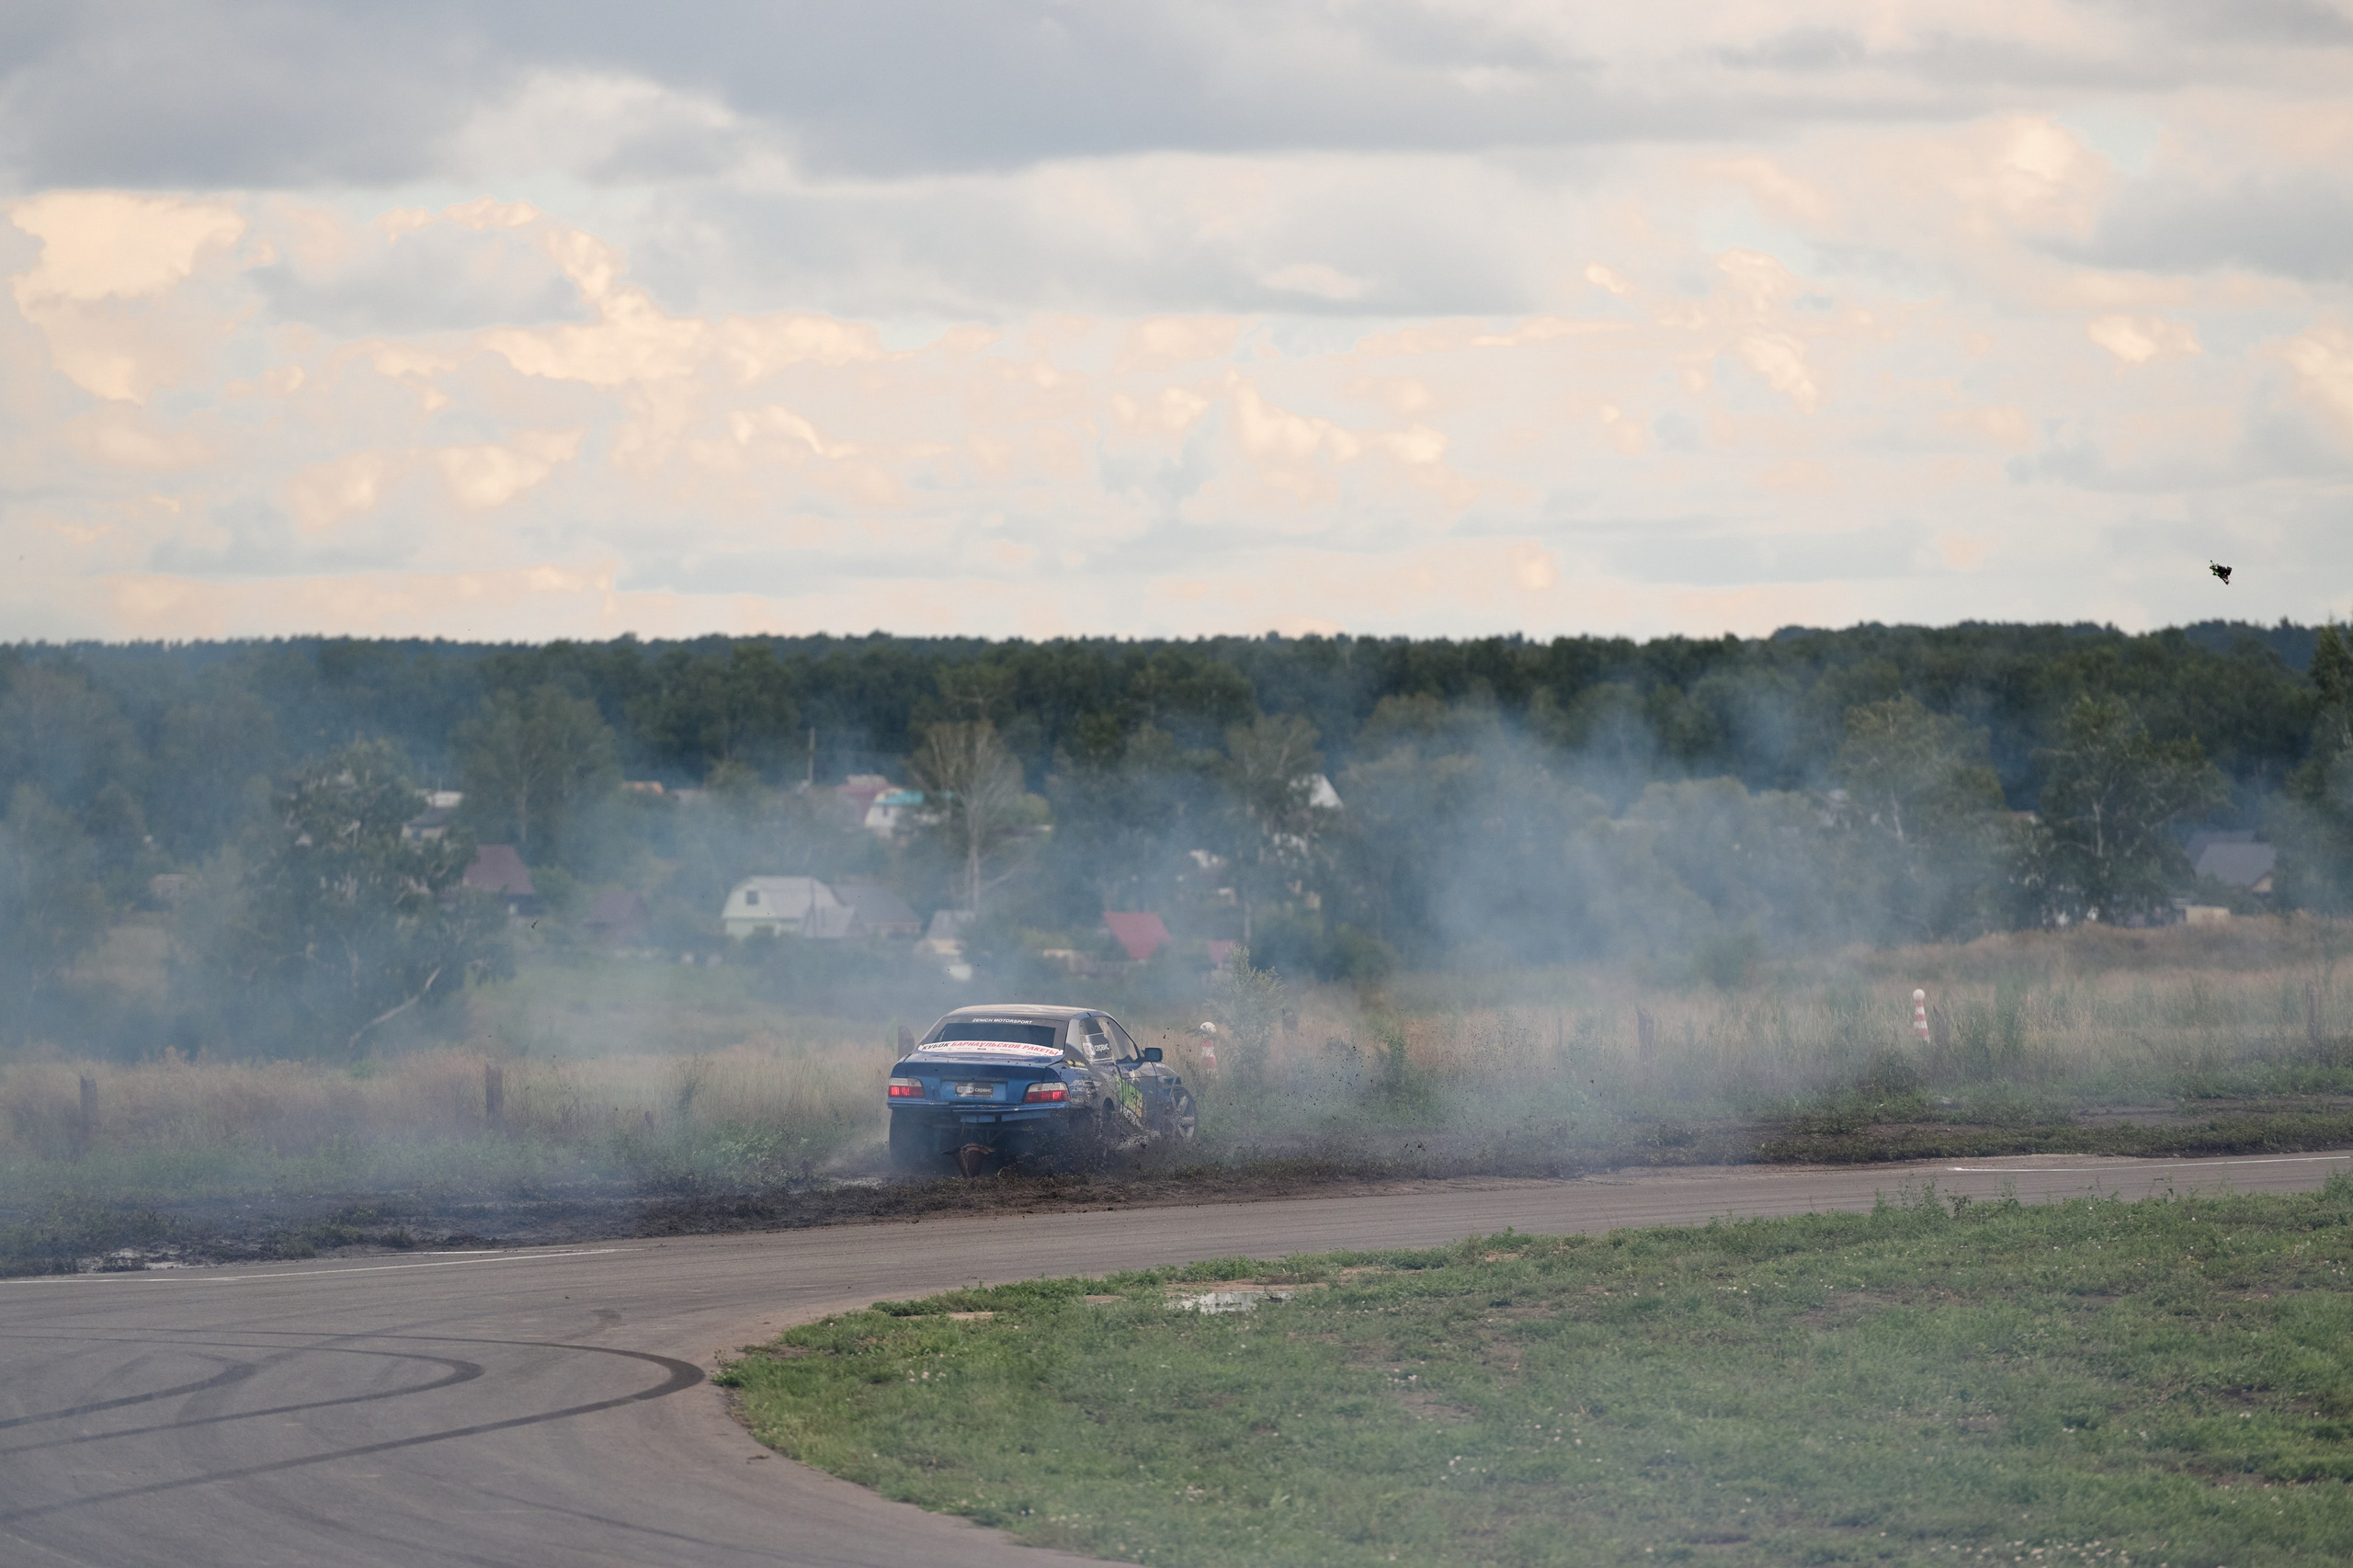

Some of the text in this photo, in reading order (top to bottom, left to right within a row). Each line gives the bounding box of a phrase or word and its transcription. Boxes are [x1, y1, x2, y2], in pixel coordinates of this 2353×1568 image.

[921, 1041, 951, 1051] КУБОК
[950, 1040, 1021, 1049] БАРНАУЛЬСКОЙ
[1022, 1044, 1059, 1056] РАКЕТЫ
